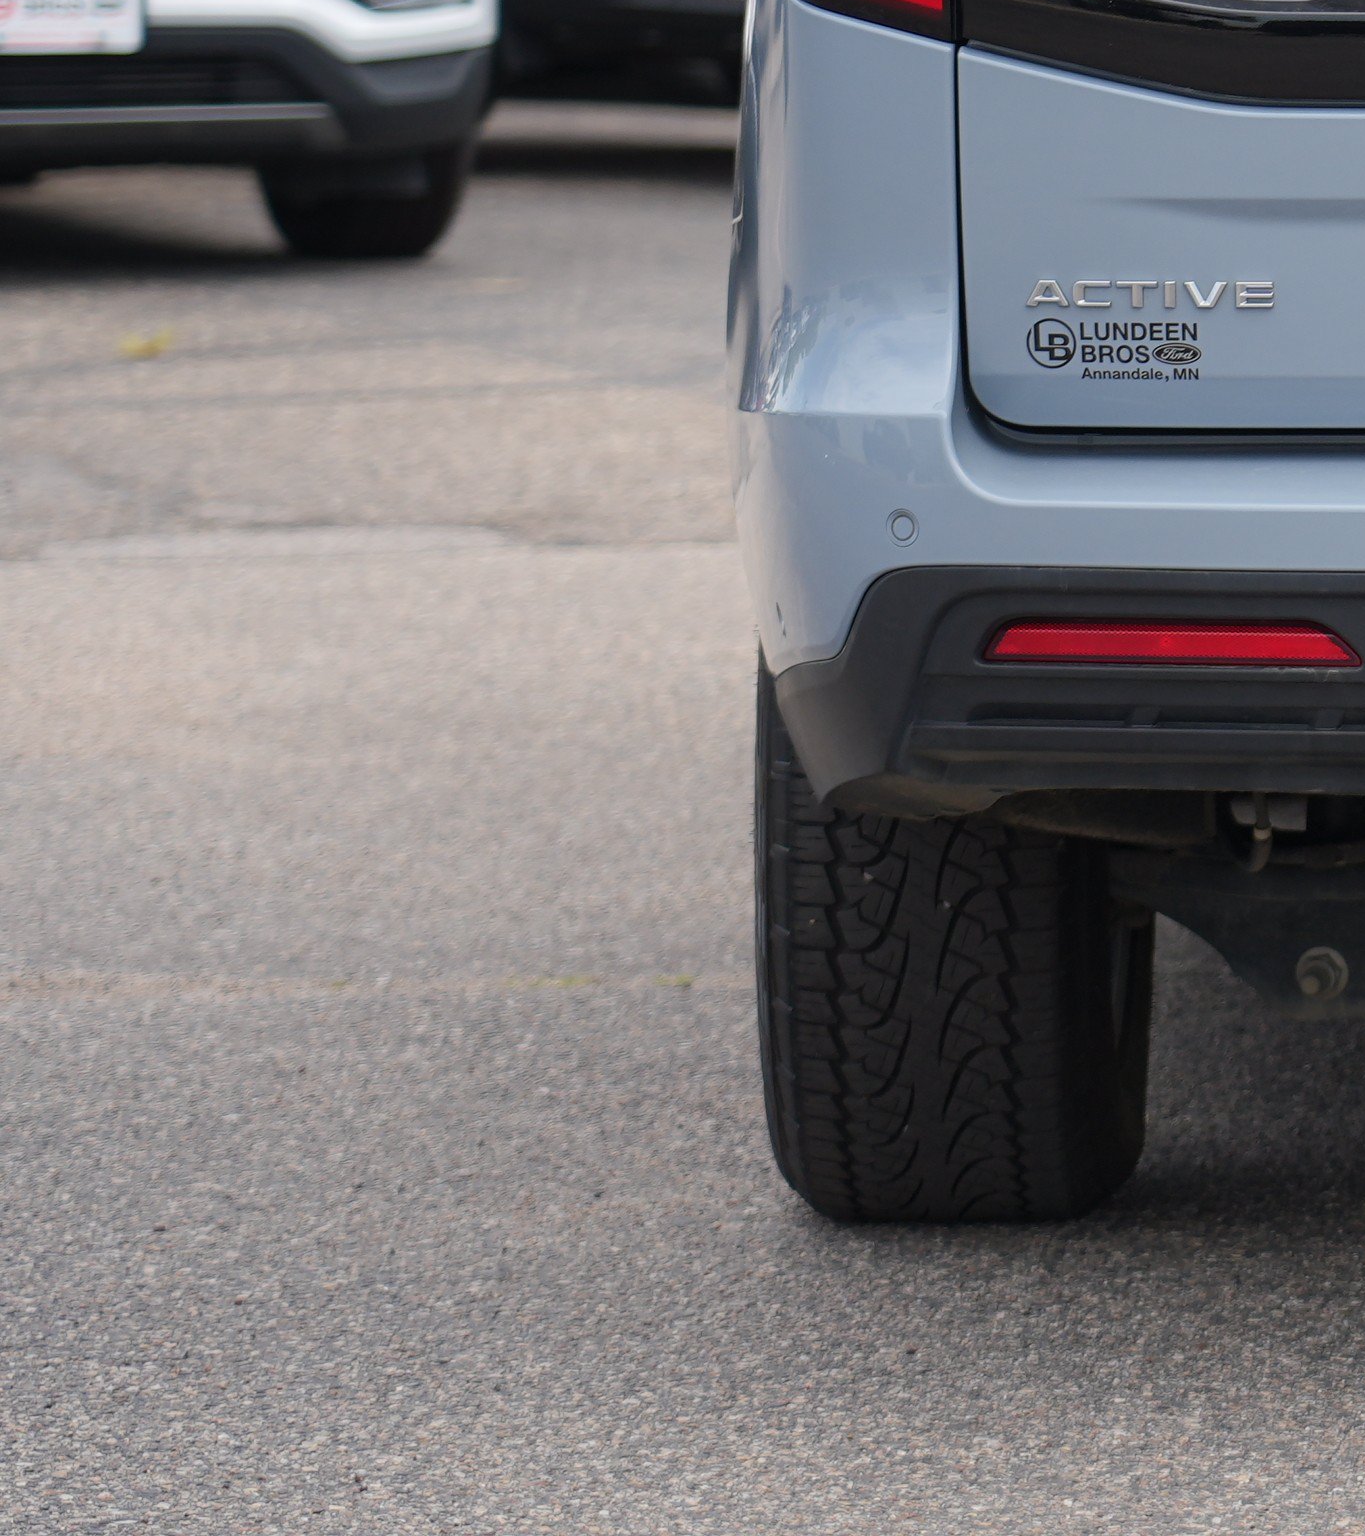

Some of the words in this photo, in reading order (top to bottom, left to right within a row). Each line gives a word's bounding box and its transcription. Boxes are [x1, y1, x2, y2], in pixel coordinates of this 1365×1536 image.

[1025, 279, 1275, 309] ACTIVE
[1079, 322, 1199, 341] LUNDEEN
[1081, 344, 1150, 364] BROS
[1160, 346, 1195, 361] Ford
[1081, 367, 1170, 382] Annandale,
[1173, 368, 1200, 381] MN
